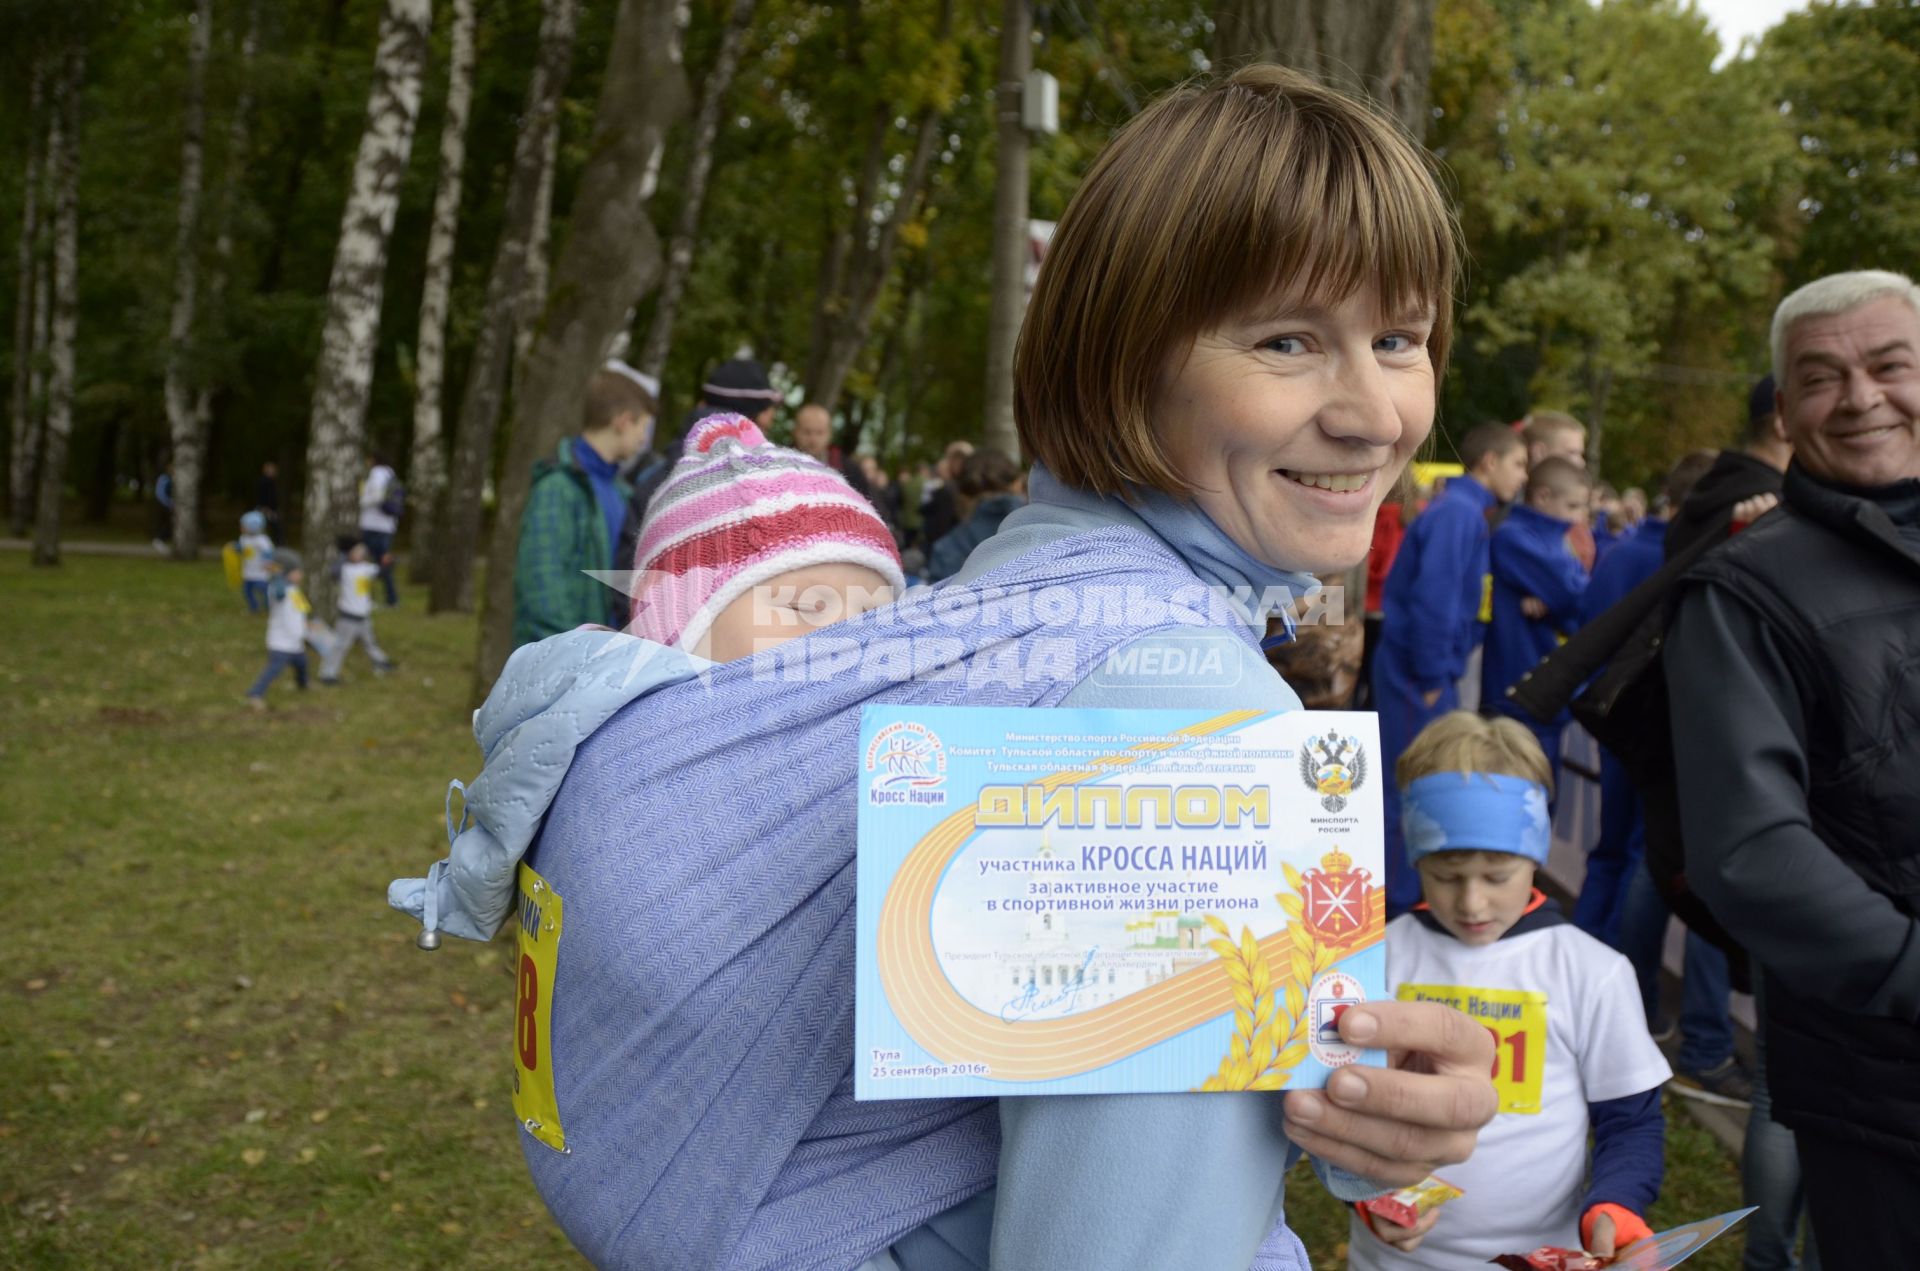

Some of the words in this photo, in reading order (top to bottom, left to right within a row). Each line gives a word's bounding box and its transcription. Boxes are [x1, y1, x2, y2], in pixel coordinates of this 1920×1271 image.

[1005, 732, 1080, 743] Министерство
[1082, 735, 1118, 744] спорта
[1120, 733, 1179, 744] Российской
[1183, 734, 1241, 745] Федерации
[949, 746, 996, 756] Комитет
[1002, 745, 1053, 758] Тульской
[1055, 746, 1100, 757] области
[1119, 750, 1158, 760] спорту
[987, 762, 1038, 773] Тульская
[1040, 761, 1098, 772] областная
[1206, 764, 1256, 774] атлетики
[871, 789, 905, 804] Кросс
[909, 789, 944, 804] Нации
[975, 784, 1270, 829] ДИПЛОМ
[979, 858, 1076, 875] участника
[1081, 845, 1174, 871] КРОССА
[1182, 841, 1267, 875] НАЦИЙ
[1053, 881, 1142, 894] активное
[1146, 881, 1219, 897] участие
[987, 900, 997, 910] в
[1002, 896, 1114, 914] спортивной
[1119, 899, 1179, 910] жизни
[1184, 898, 1259, 913] региона
[1468, 996, 1523, 1021] Нации
[872, 1050, 901, 1062] Тула
[872, 1067, 887, 1077] 25
[890, 1065, 948, 1077] сентября
[951, 1063, 990, 1074] 2016г.
